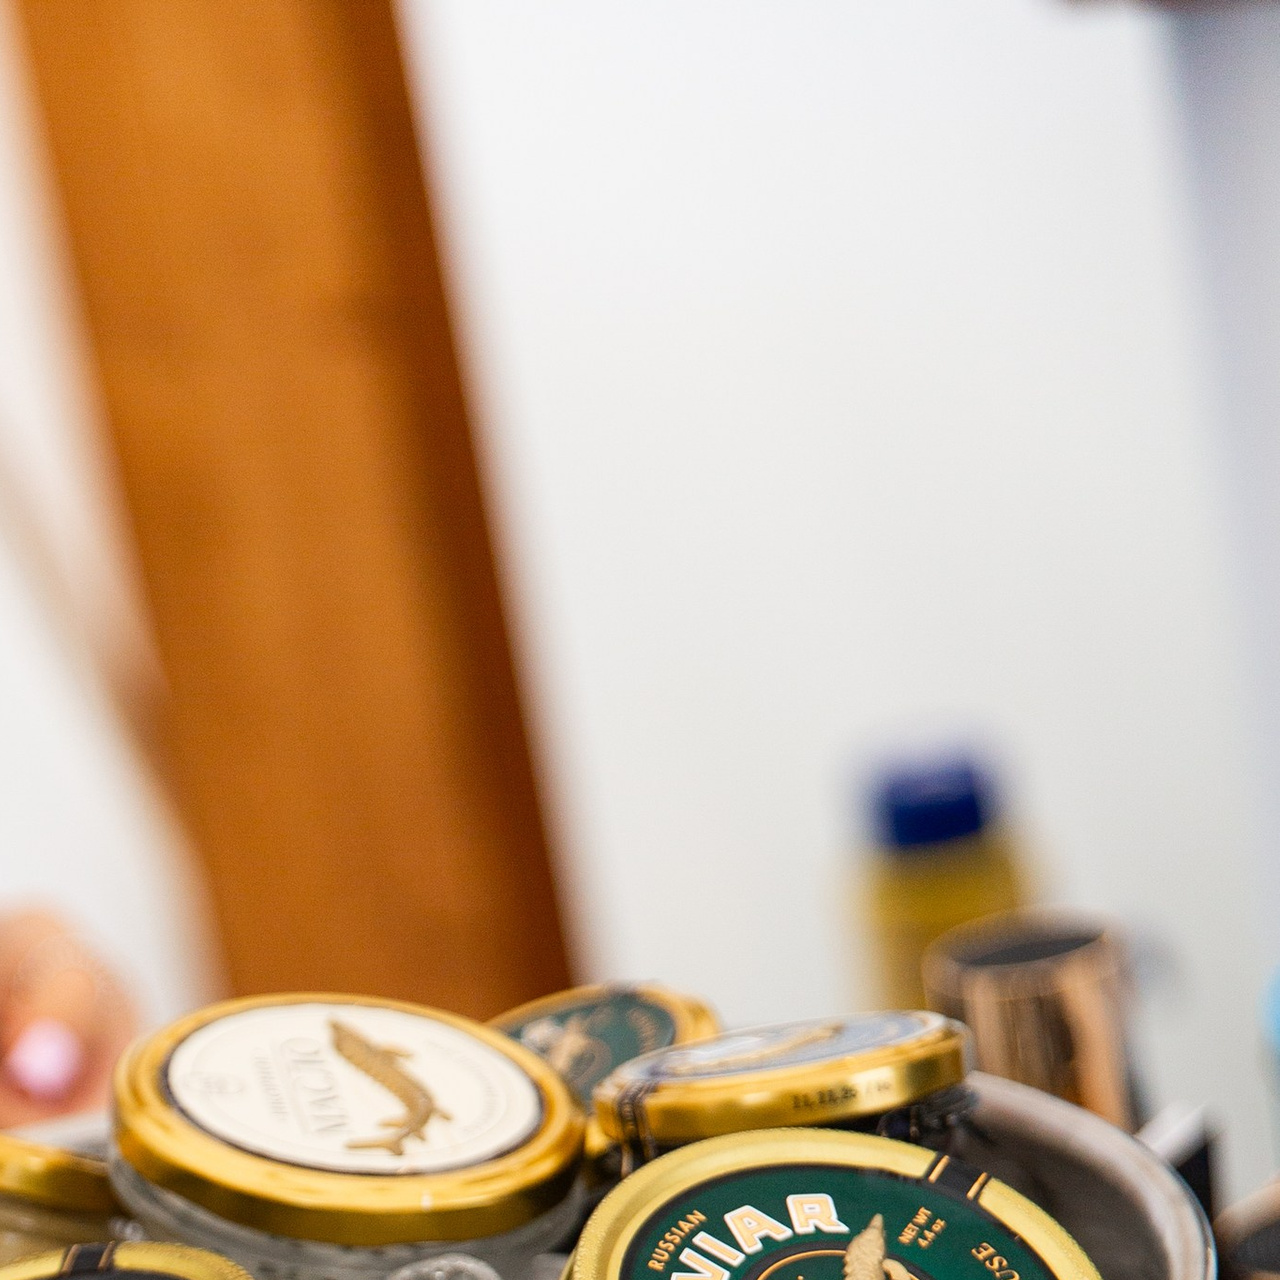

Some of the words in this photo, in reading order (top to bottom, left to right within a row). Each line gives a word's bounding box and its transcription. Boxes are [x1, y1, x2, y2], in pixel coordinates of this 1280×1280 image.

[647, 1209, 708, 1273] RUSSIAN
[898, 1222, 920, 1245] NET
[914, 1207, 932, 1228] WT
